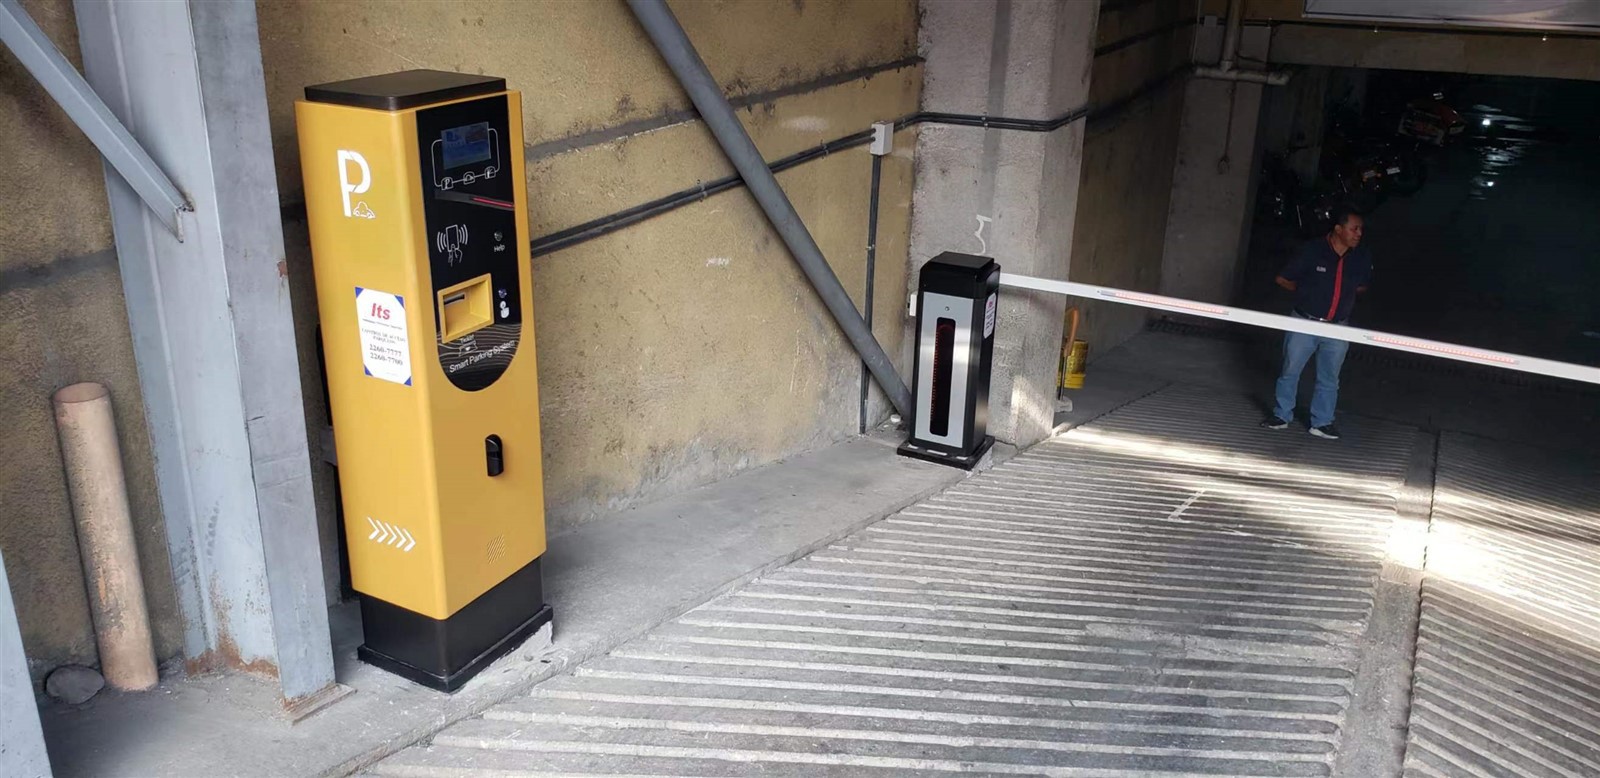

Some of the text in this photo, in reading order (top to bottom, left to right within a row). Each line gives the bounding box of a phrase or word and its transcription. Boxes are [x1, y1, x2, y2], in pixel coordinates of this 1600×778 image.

[337, 149, 371, 217] P
[493, 243, 506, 253] Help
[371, 302, 391, 320] Its
[449, 340, 516, 373] Smart Parking System
